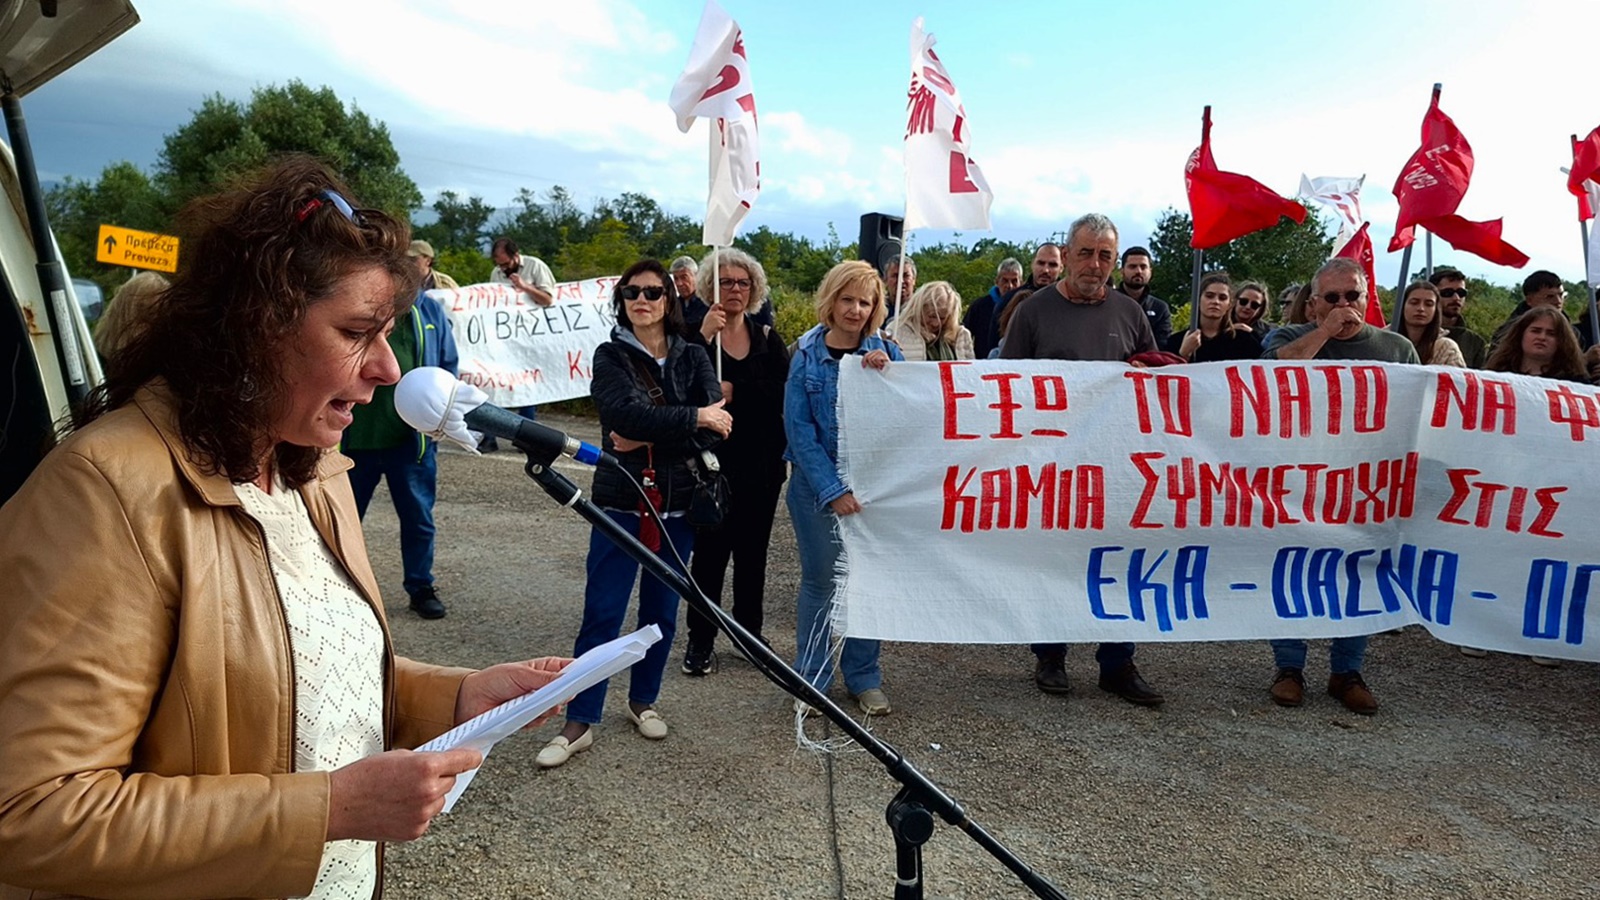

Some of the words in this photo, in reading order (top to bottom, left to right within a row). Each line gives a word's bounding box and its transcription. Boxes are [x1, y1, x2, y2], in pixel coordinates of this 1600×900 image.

[124, 249, 169, 266] Preveza
[451, 281, 583, 312] ΣΥΜΜΕΧΗ
[596, 277, 620, 300] ΣΤ
[467, 313, 487, 345] ΟΙ
[496, 303, 590, 340] ΒΑΣΕΙΣ
[592, 302, 617, 328] Κ
[567, 350, 592, 380] Κι
[1124, 371, 1192, 437] ΤΟ
[1225, 365, 1388, 438] ΝΑΤΟ
[1431, 372, 1517, 435] ΝΑ
[1546, 385, 1600, 441] Φ
[941, 462, 1104, 531] ΚΑΜΙΑ
[1129, 451, 1418, 529] ΣΥΜΜΕΤΟΧΗ
[1437, 468, 1568, 538] ΣΤΙΣ
[1087, 545, 1209, 632] ΕΚΑ
